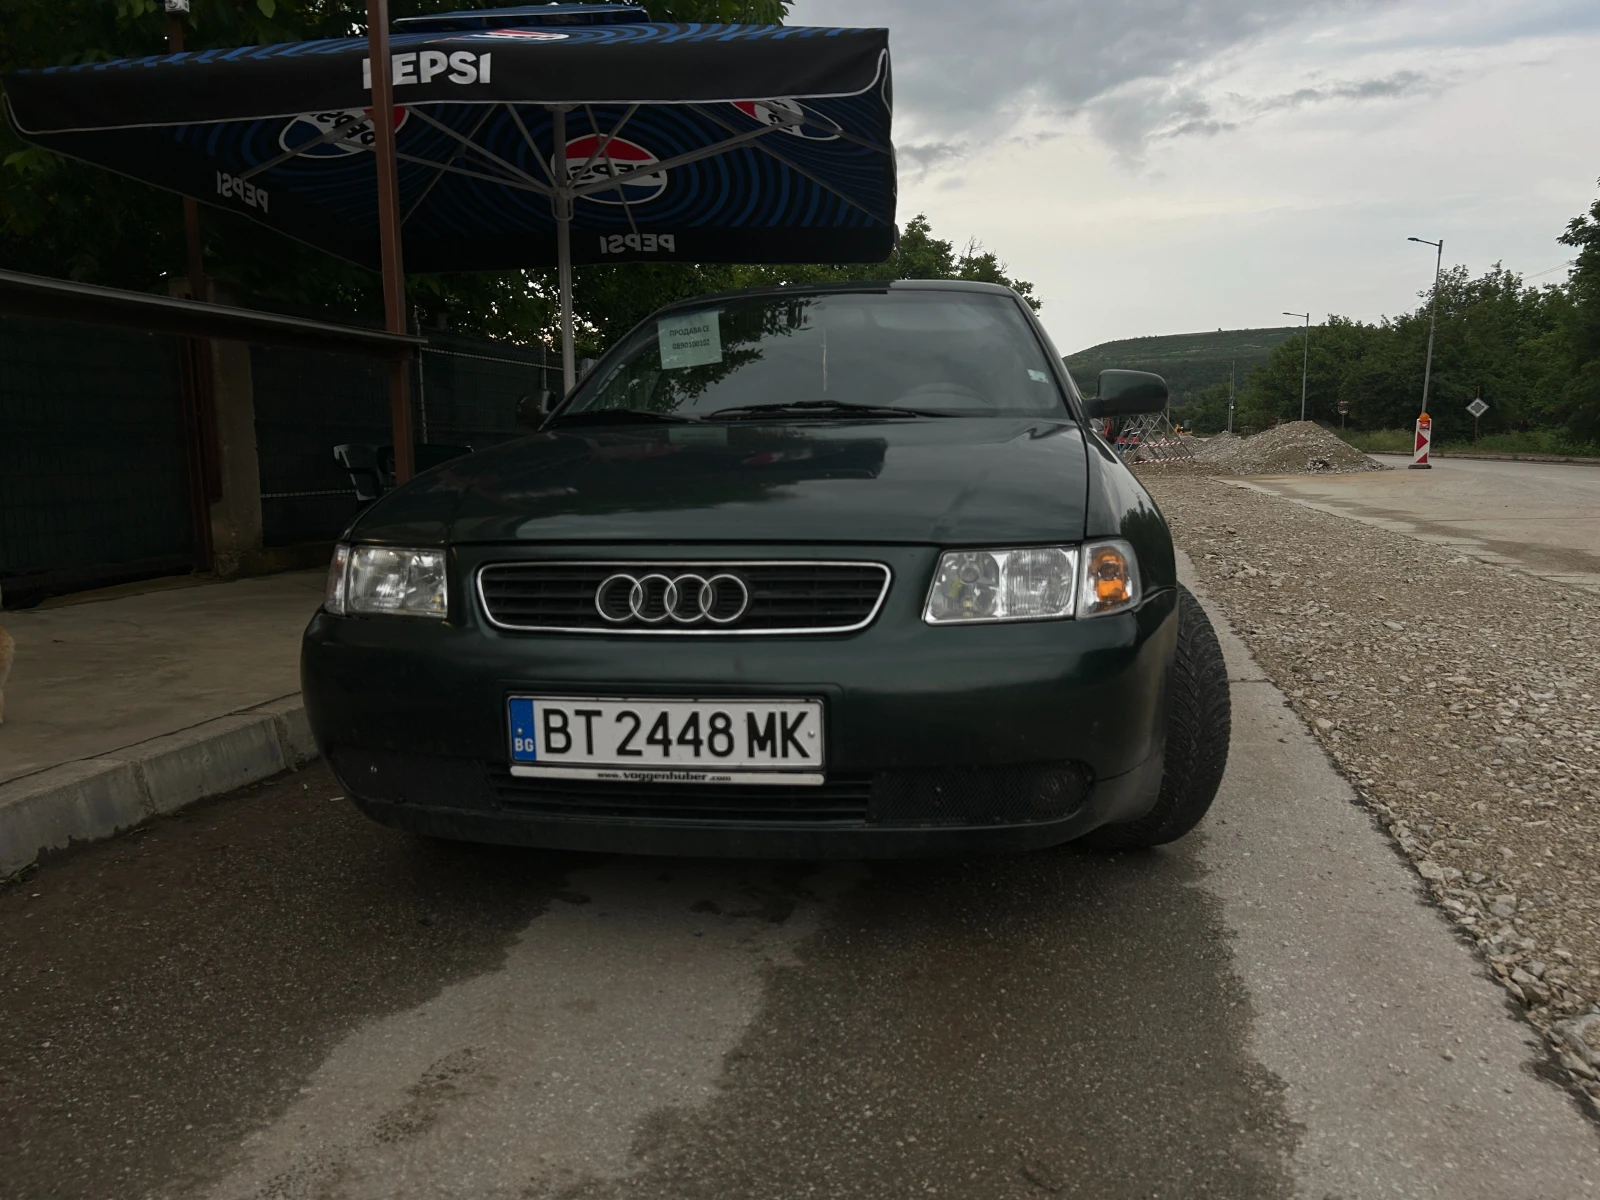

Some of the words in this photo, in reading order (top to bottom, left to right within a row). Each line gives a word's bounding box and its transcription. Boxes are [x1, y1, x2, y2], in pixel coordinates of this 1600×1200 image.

[669, 327, 702, 336] ПРОДАВА
[542, 707, 603, 756] BT
[614, 709, 736, 758] 2448
[746, 711, 811, 759] MK
[514, 737, 534, 753] BG
